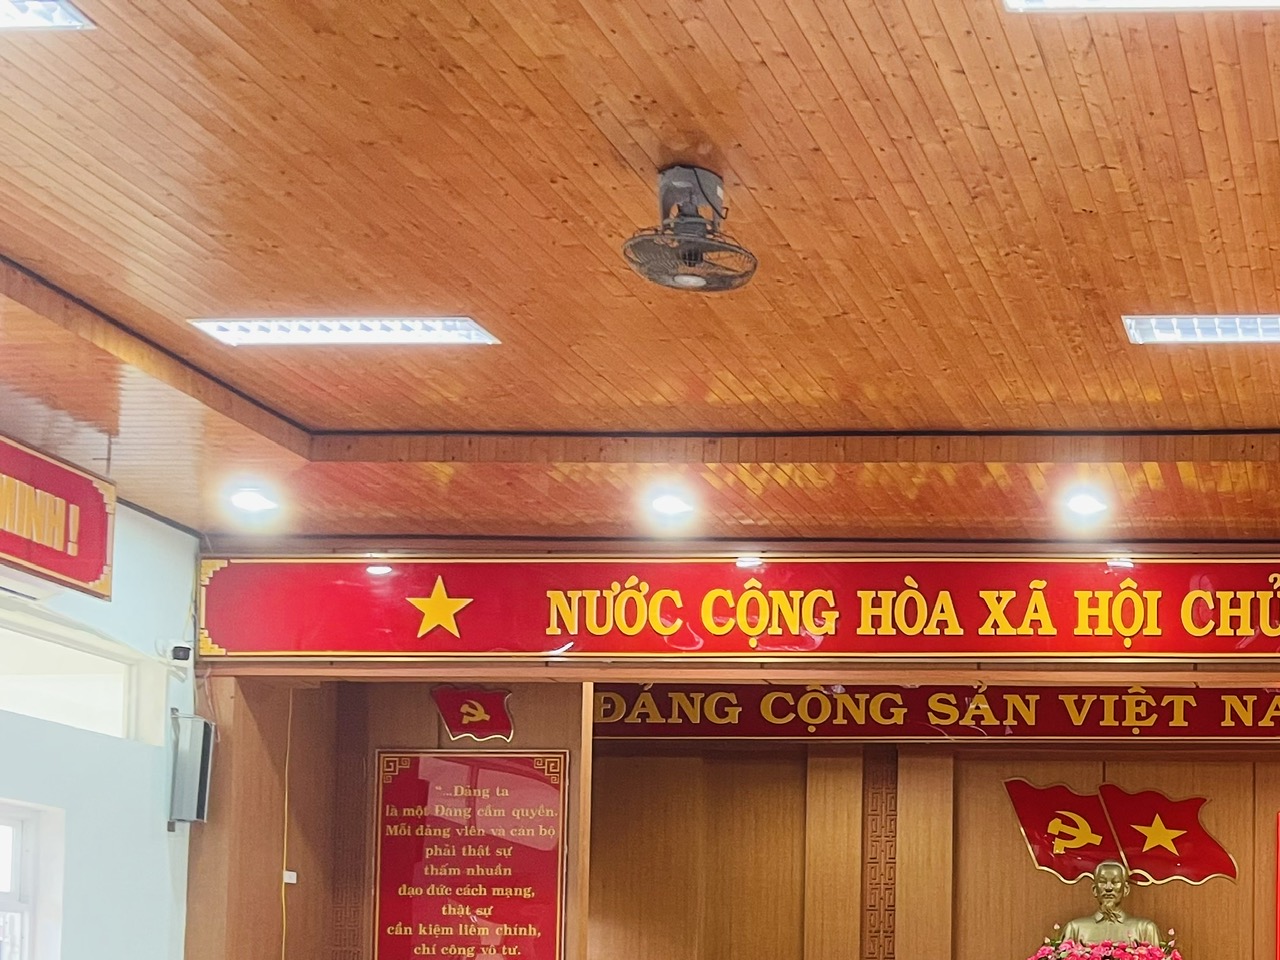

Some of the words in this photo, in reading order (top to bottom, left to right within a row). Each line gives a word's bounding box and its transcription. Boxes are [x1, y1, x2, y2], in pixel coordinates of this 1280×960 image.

[547, 575, 684, 637] NƯỚC
[702, 578, 840, 649] CỘNG
[857, 576, 964, 637] HÒA
[977, 579, 1058, 637] XÃ
[1073, 577, 1163, 650] HỘI
[760, 683, 908, 733] CỘNG
[927, 682, 1040, 726] SẢN
[1058, 685, 1197, 735] VIỆT
[425, 844, 456, 857] phải
[462, 845, 491, 857] thật
[496, 846, 513, 857] sự
[424, 862, 461, 876] thấm
[398, 884, 423, 898] đạo
[427, 884, 452, 896] đức
[456, 884, 487, 896] cách
[492, 886, 535, 898] mạng,
[442, 904, 472, 917] thật
[476, 906, 493, 917] sự
[387, 922, 413, 935] cần
[419, 924, 453, 937] kiệm
[459, 924, 489, 936] liêm
[496, 924, 541, 938] chính,
[414, 944, 436, 955] chí
[441, 945, 475, 957] công
[482, 945, 496, 955] vô
